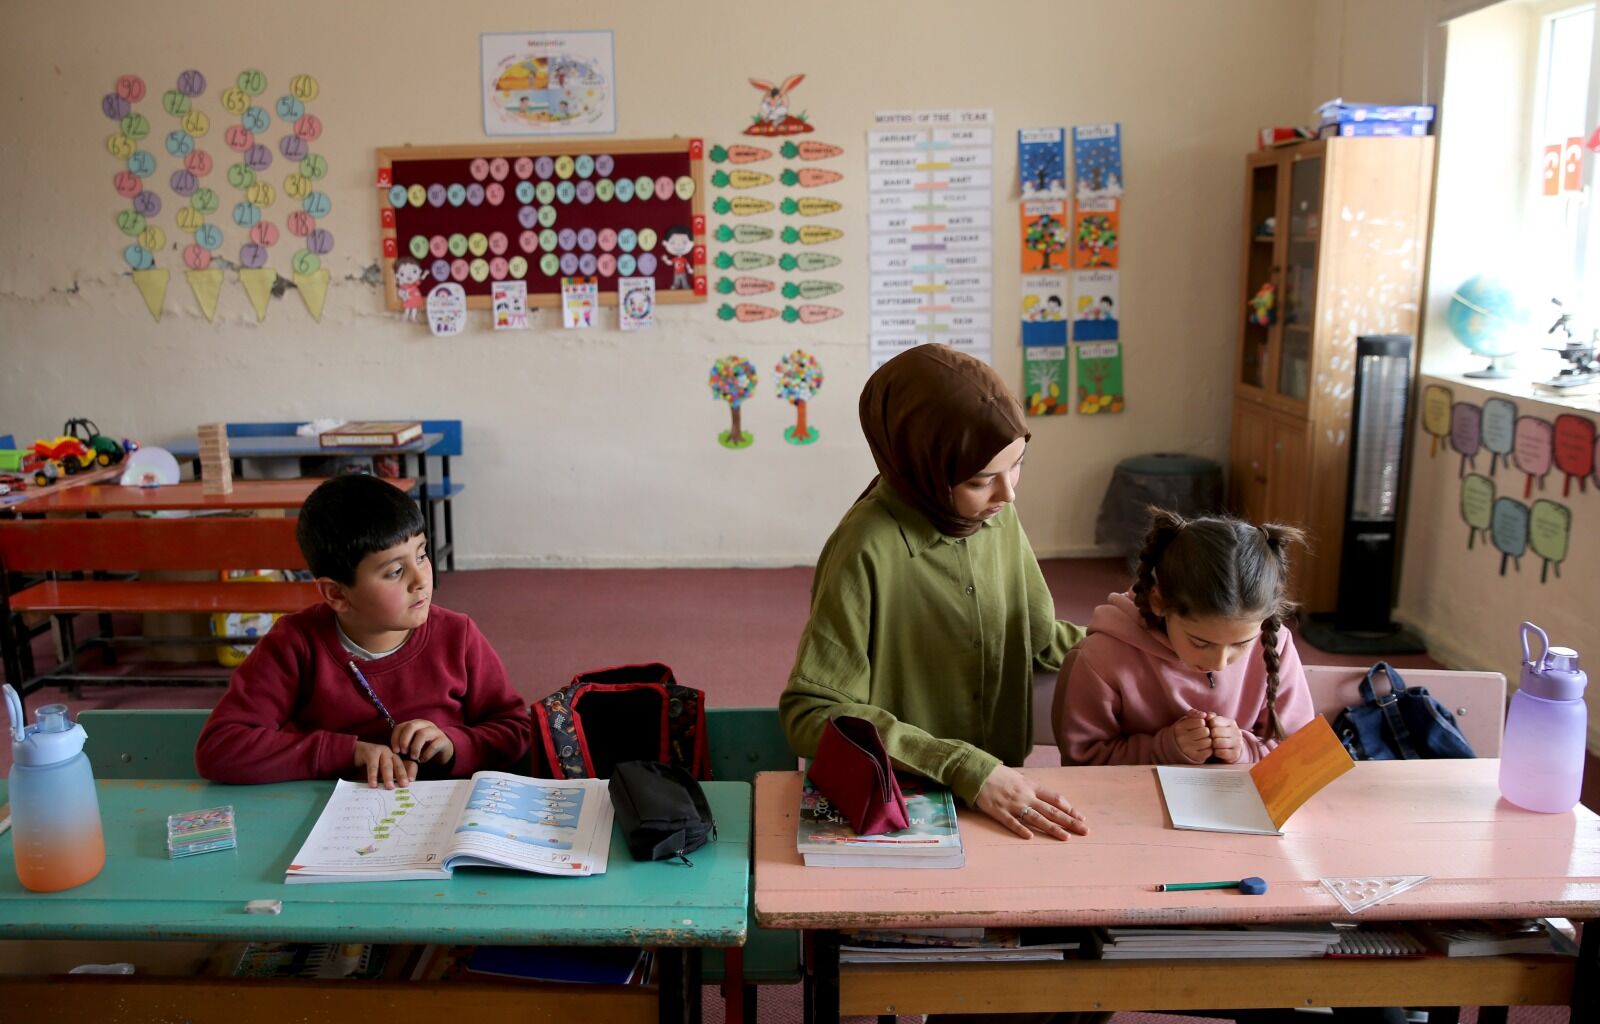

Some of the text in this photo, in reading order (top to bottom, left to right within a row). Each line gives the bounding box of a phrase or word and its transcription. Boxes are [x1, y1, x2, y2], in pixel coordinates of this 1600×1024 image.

[122, 79, 142, 99] 90
[182, 71, 204, 96] 80
[241, 72, 261, 92] 70
[294, 75, 313, 99] 60
[107, 97, 120, 117] 81
[167, 91, 187, 114] 72
[226, 91, 246, 112] 63
[127, 115, 146, 135] 72
[246, 107, 264, 129] 56
[112, 134, 131, 157] 63
[170, 133, 190, 154] 56
[234, 161, 254, 188] 35
[305, 155, 323, 178] 36
[253, 183, 271, 206] 28
[288, 174, 308, 199] 30
[139, 192, 155, 211] 36
[199, 188, 214, 210] 32
[122, 212, 138, 231] 27
[239, 204, 253, 225] 21
[294, 211, 310, 237] 18
[143, 226, 158, 249] 18
[203, 226, 217, 246] 16
[312, 229, 328, 254] 12
[134, 247, 144, 266] 9
[192, 245, 203, 268] 8
[245, 243, 259, 265] 7
[299, 251, 312, 273] 6
